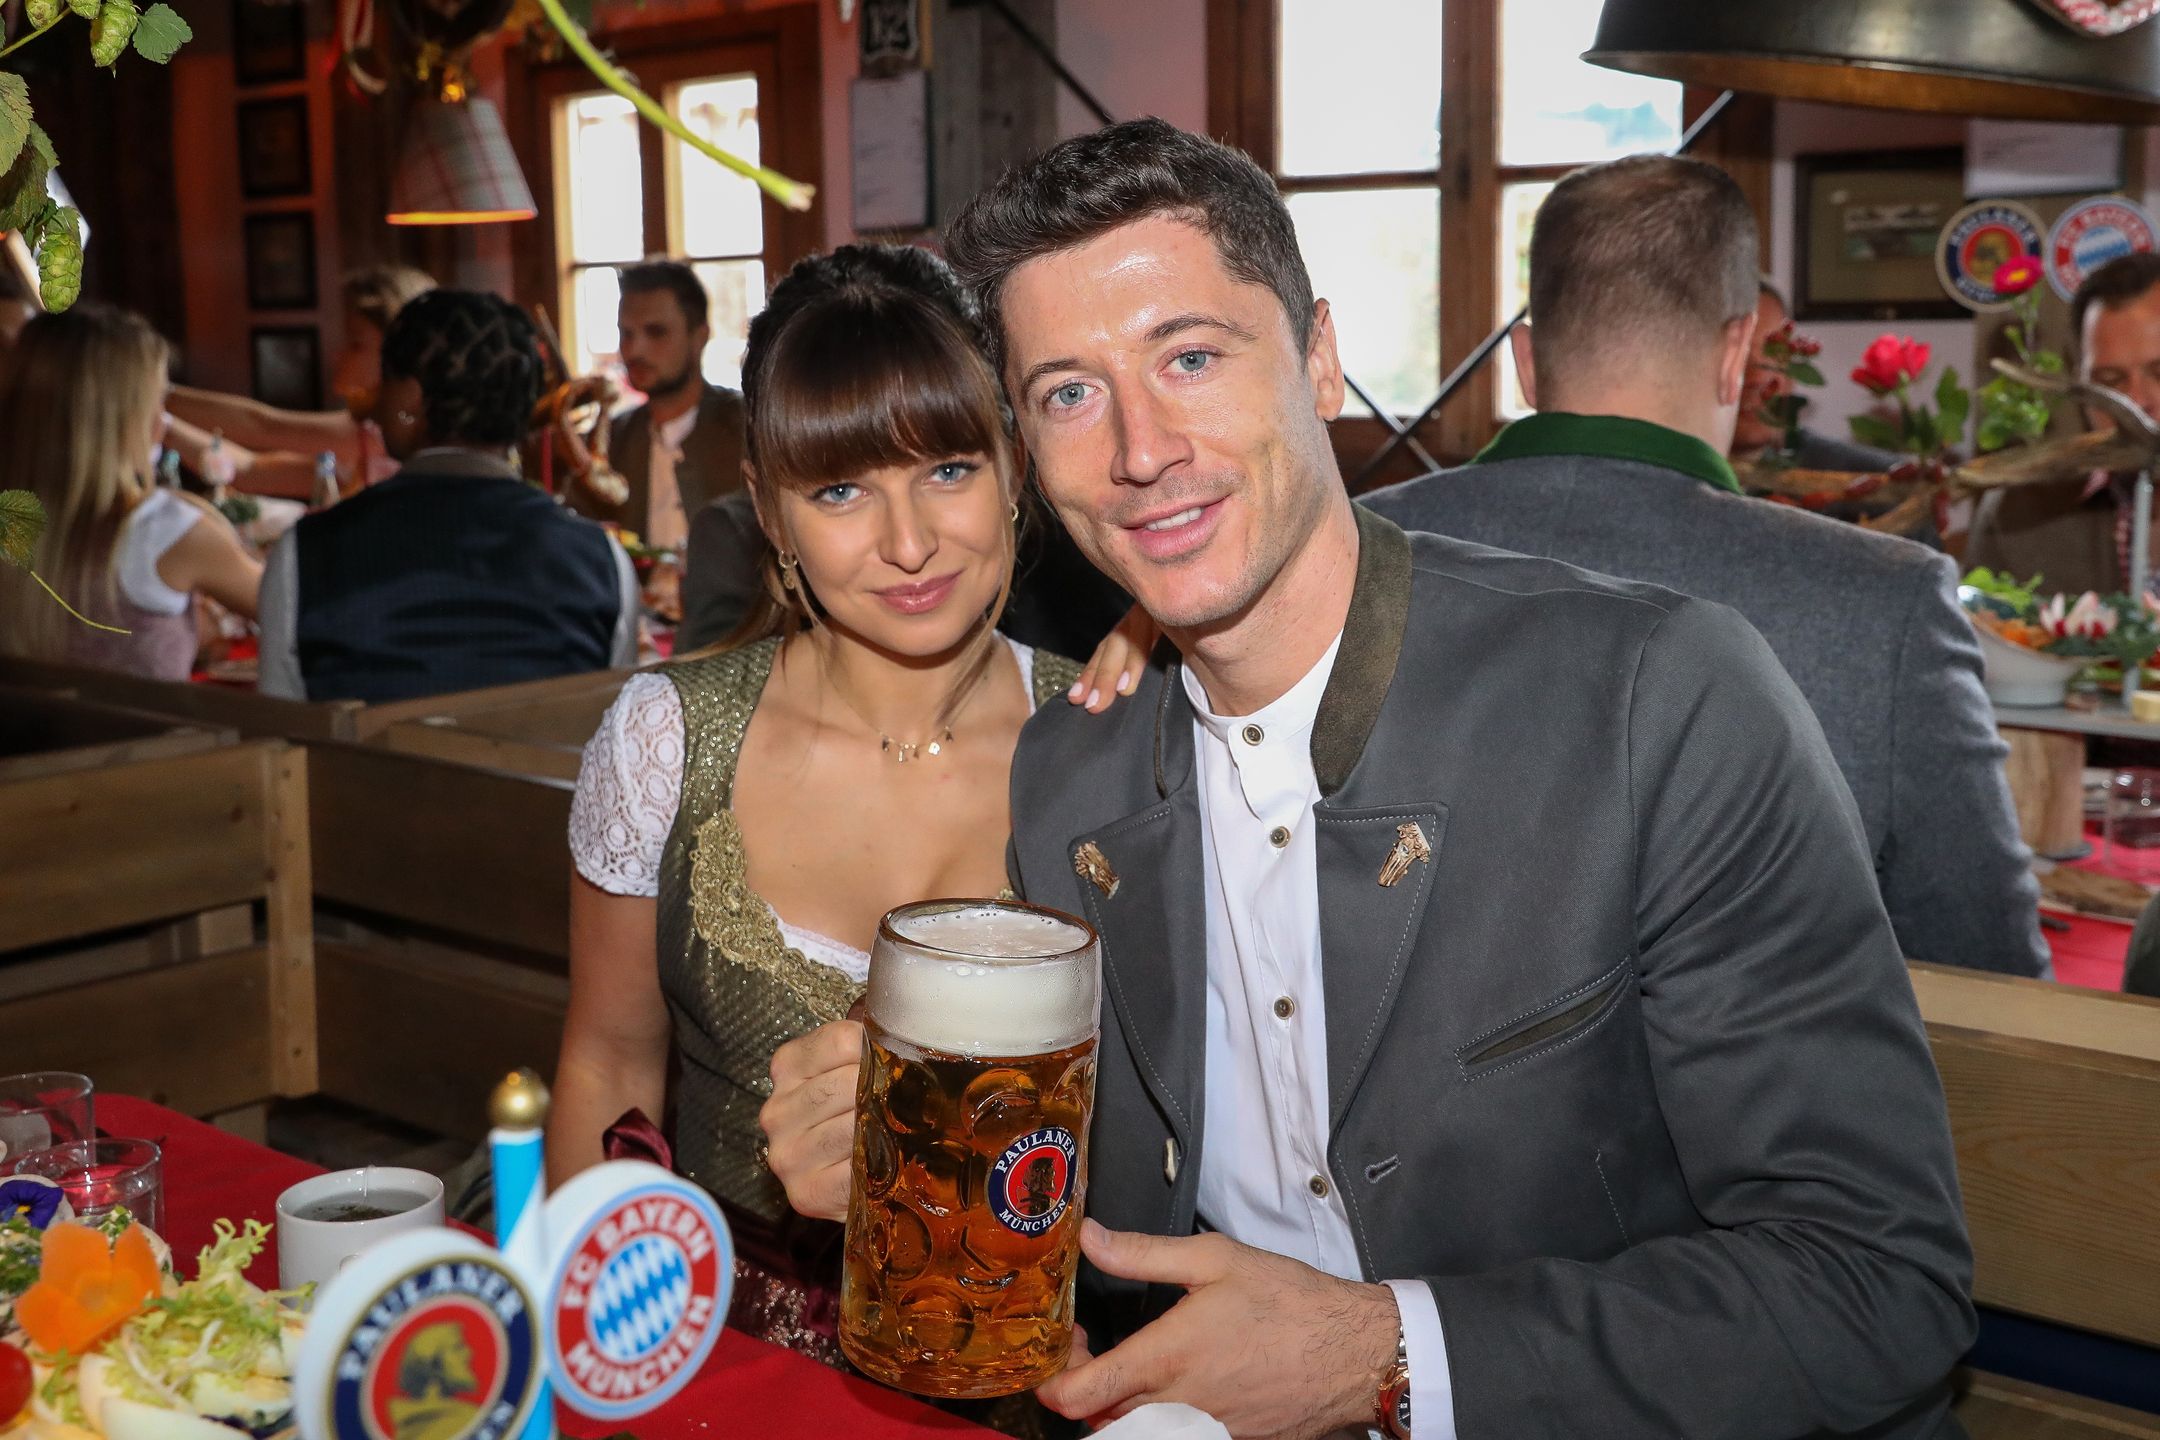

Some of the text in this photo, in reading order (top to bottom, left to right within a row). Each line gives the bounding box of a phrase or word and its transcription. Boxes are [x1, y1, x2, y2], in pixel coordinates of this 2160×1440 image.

[995, 1130, 1075, 1174] PAULANER
[999, 1198, 1067, 1232] MÜNCHEN
[563, 1202, 714, 1308] FC BAYERN
[338, 1263, 523, 1380] PAULANER
